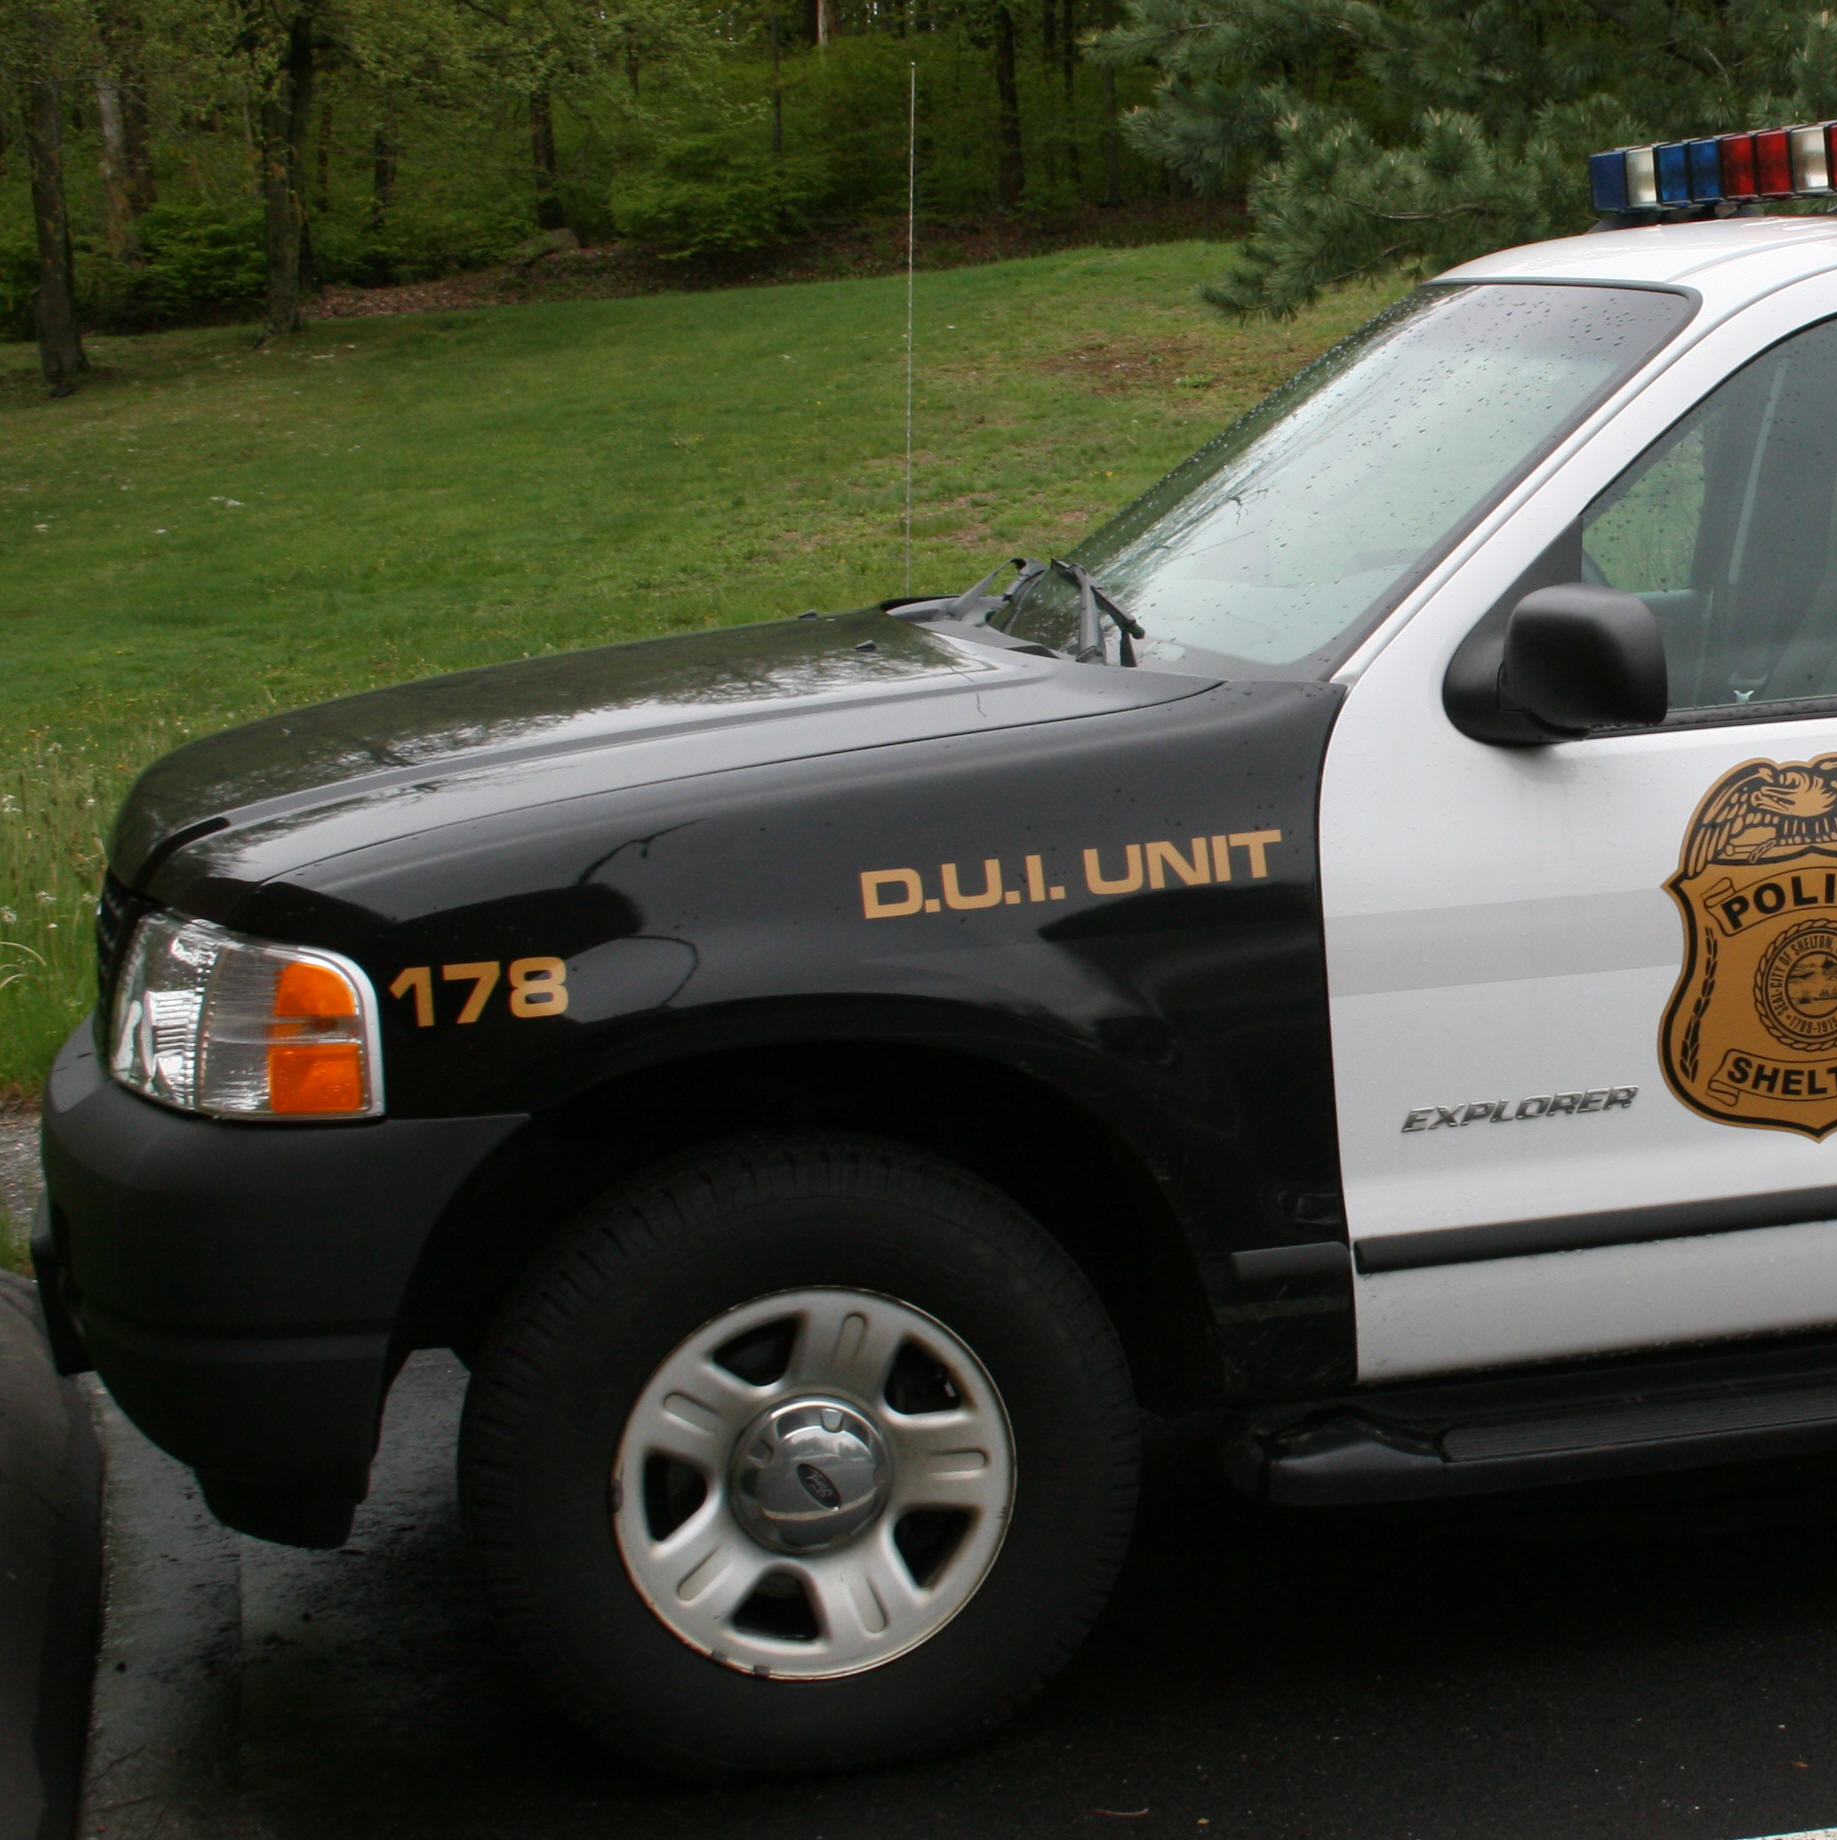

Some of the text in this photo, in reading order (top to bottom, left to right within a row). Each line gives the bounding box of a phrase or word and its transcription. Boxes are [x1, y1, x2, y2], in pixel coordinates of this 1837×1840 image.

[860, 830, 1282, 919] D.U.I. UNIT
[389, 956, 569, 1027] 178
[1400, 1085, 1640, 1133] EXPLORER
